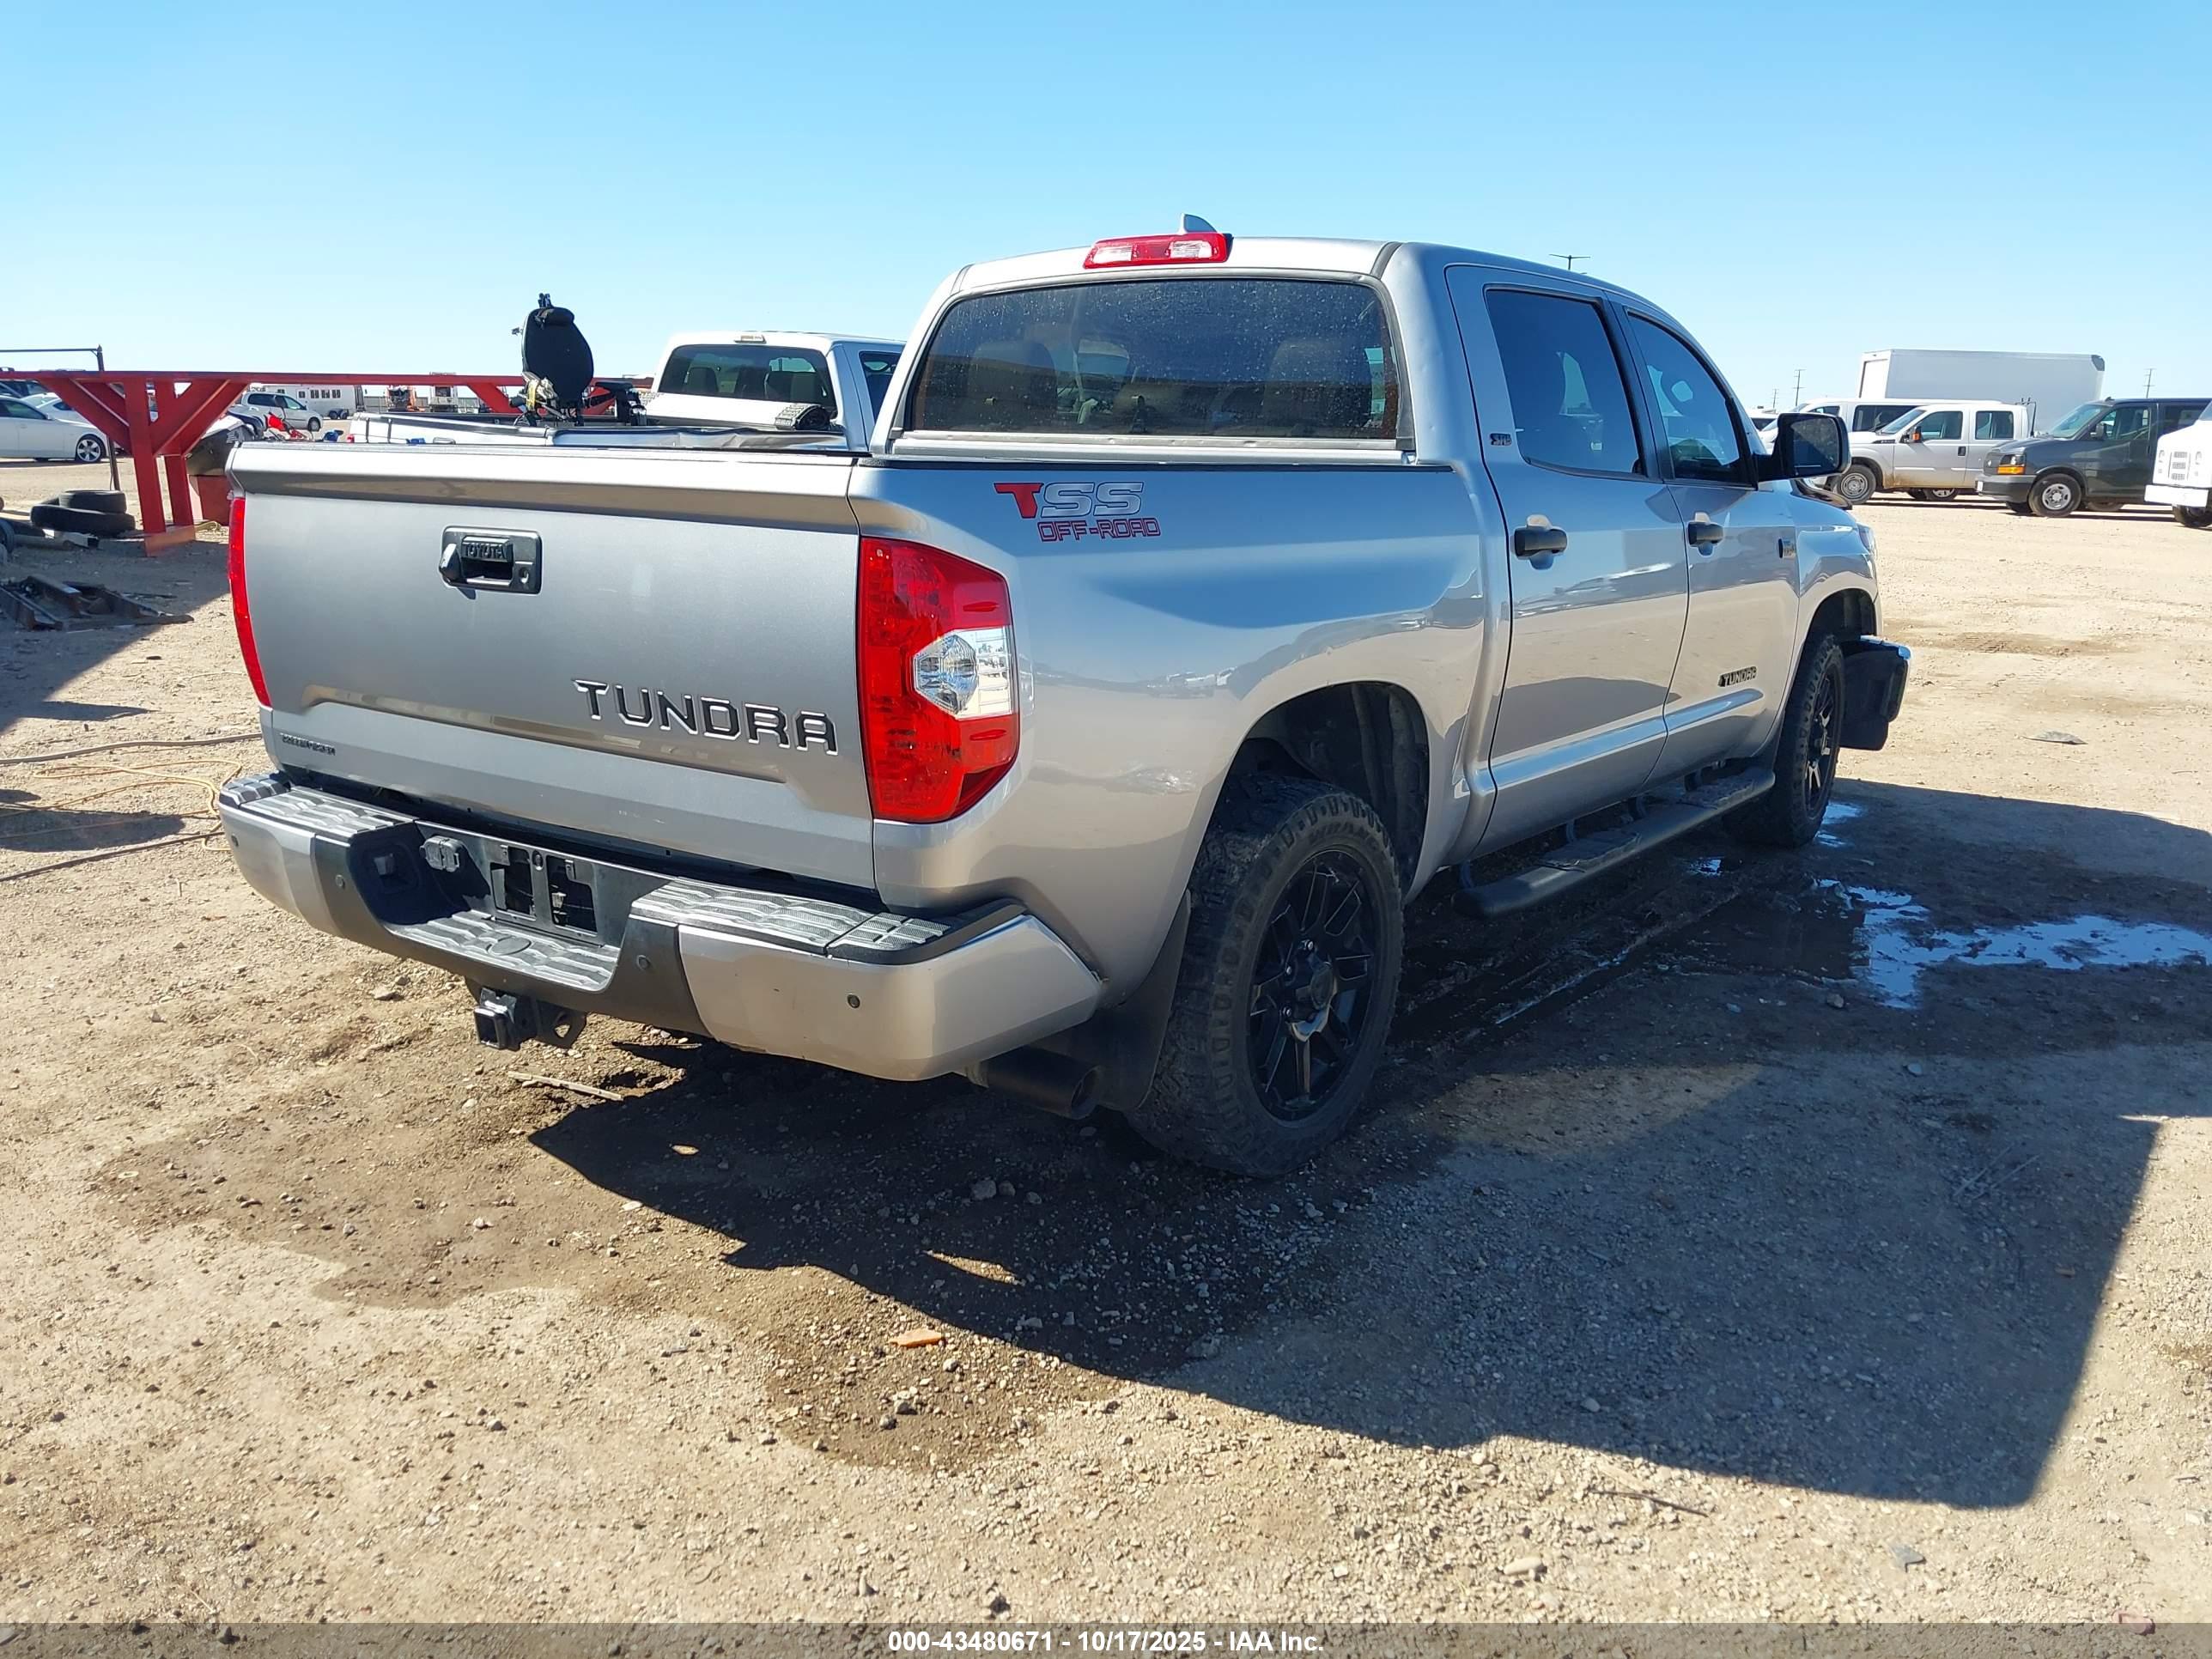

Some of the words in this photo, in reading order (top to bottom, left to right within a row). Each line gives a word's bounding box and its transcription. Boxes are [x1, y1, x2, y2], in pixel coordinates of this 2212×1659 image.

[994, 482, 1144, 519] TSS
[1037, 519, 1161, 542] OFF-ROAD
[463, 543, 507, 558] TOYOTA
[1721, 666, 1757, 687] TUNDRA
[572, 678, 839, 756] TUNDRA
